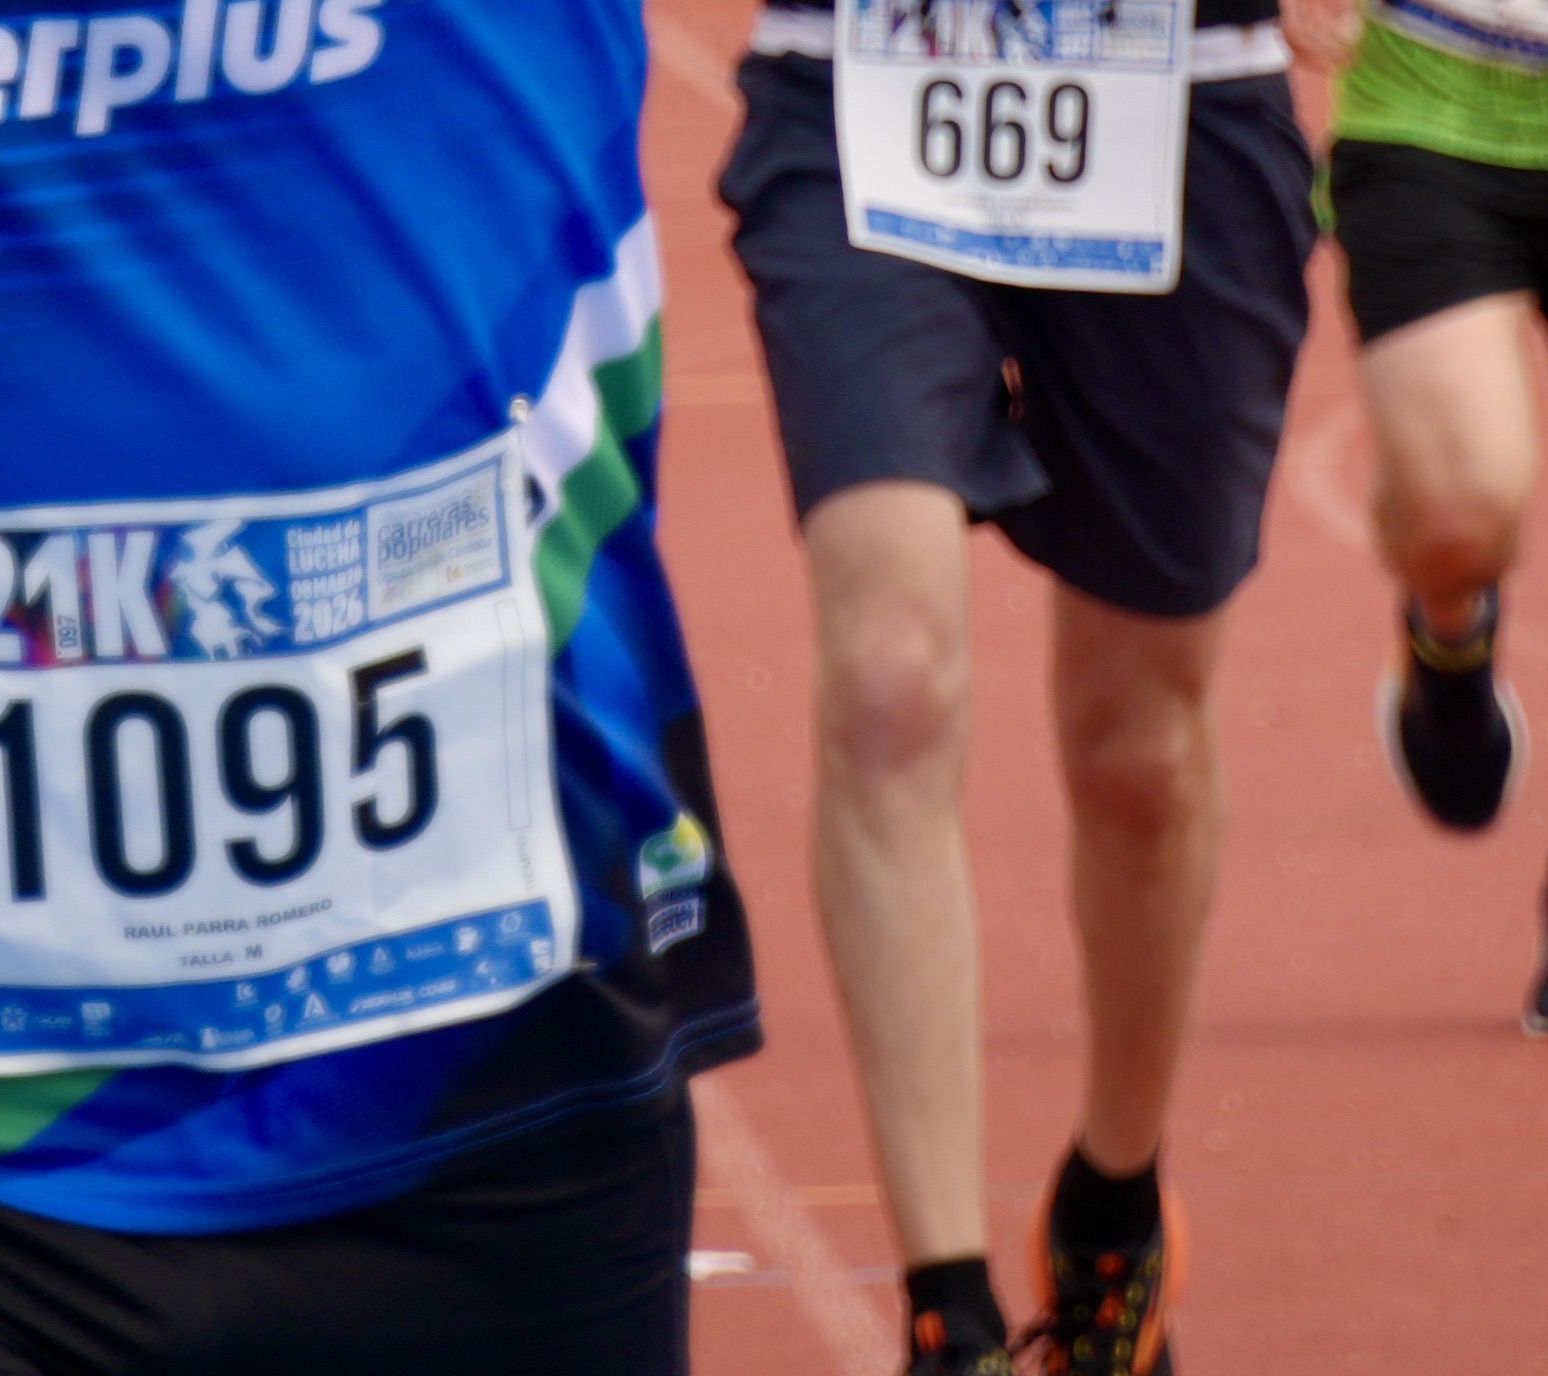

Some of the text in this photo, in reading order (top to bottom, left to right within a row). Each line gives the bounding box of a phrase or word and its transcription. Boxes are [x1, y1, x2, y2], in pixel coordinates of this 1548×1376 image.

[920, 80, 1089, 182] 669
[289, 538, 361, 576] LUCENA
[293, 589, 364, 643] 2026
[123, 898, 333, 940] RAUL PARRA ROMERO
